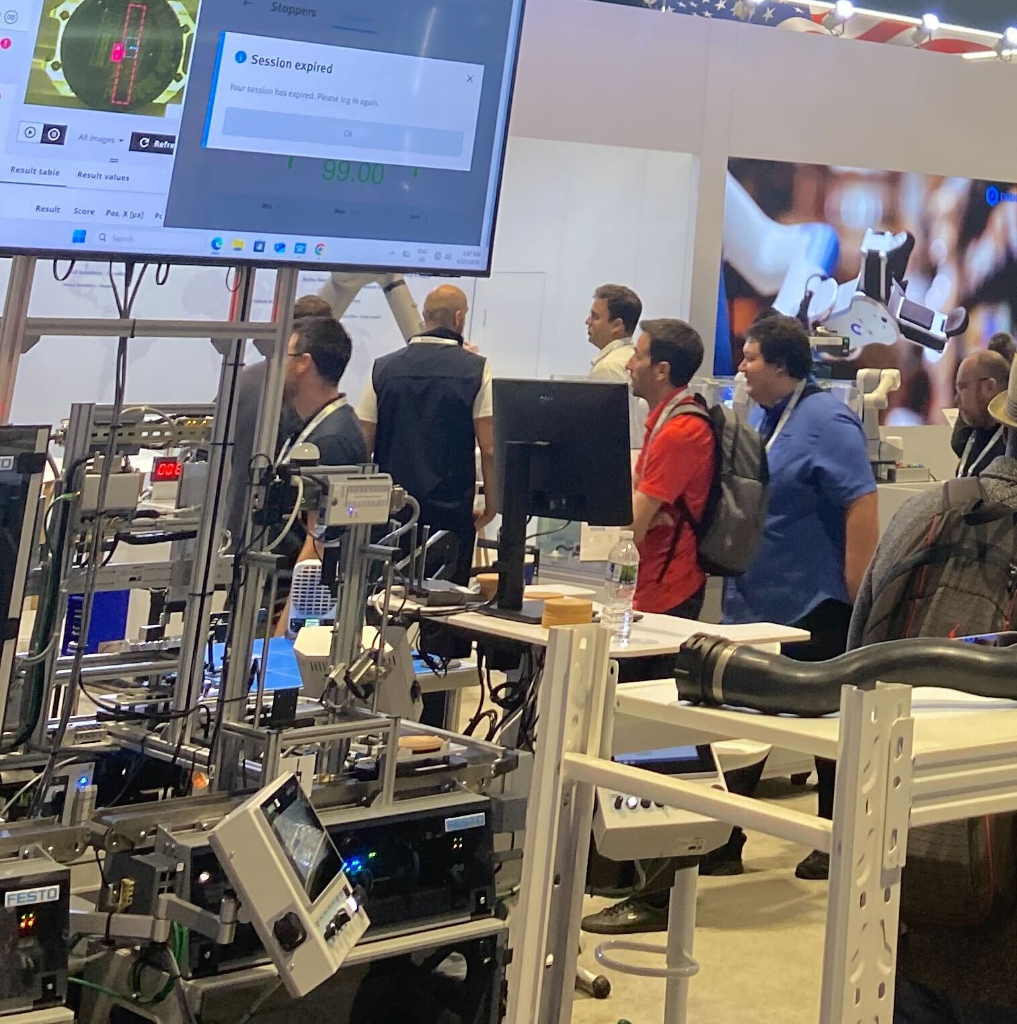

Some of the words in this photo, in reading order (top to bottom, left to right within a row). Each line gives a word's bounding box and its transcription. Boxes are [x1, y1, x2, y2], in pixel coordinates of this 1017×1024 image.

[270, 1, 318, 18] Stoppers
[250, 53, 292, 70] Session
[294, 61, 334, 74] expired
[230, 82, 246, 93] Your
[246, 85, 273, 95] session
[274, 87, 287, 97] has
[317, 92, 339, 103] Please
[340, 95, 351, 106] log
[77, 133, 88, 142] All
[89, 133, 115, 144] images
[10, 166, 37, 175] Result
[39, 168, 60, 176] table
[77, 171, 102, 180] Result
[104, 173, 130, 182] values
[322, 158, 385, 185] 99.00
[35, 205, 61, 214] Result
[74, 207, 95, 216] Score
[7, 887, 58, 906] FESTO
